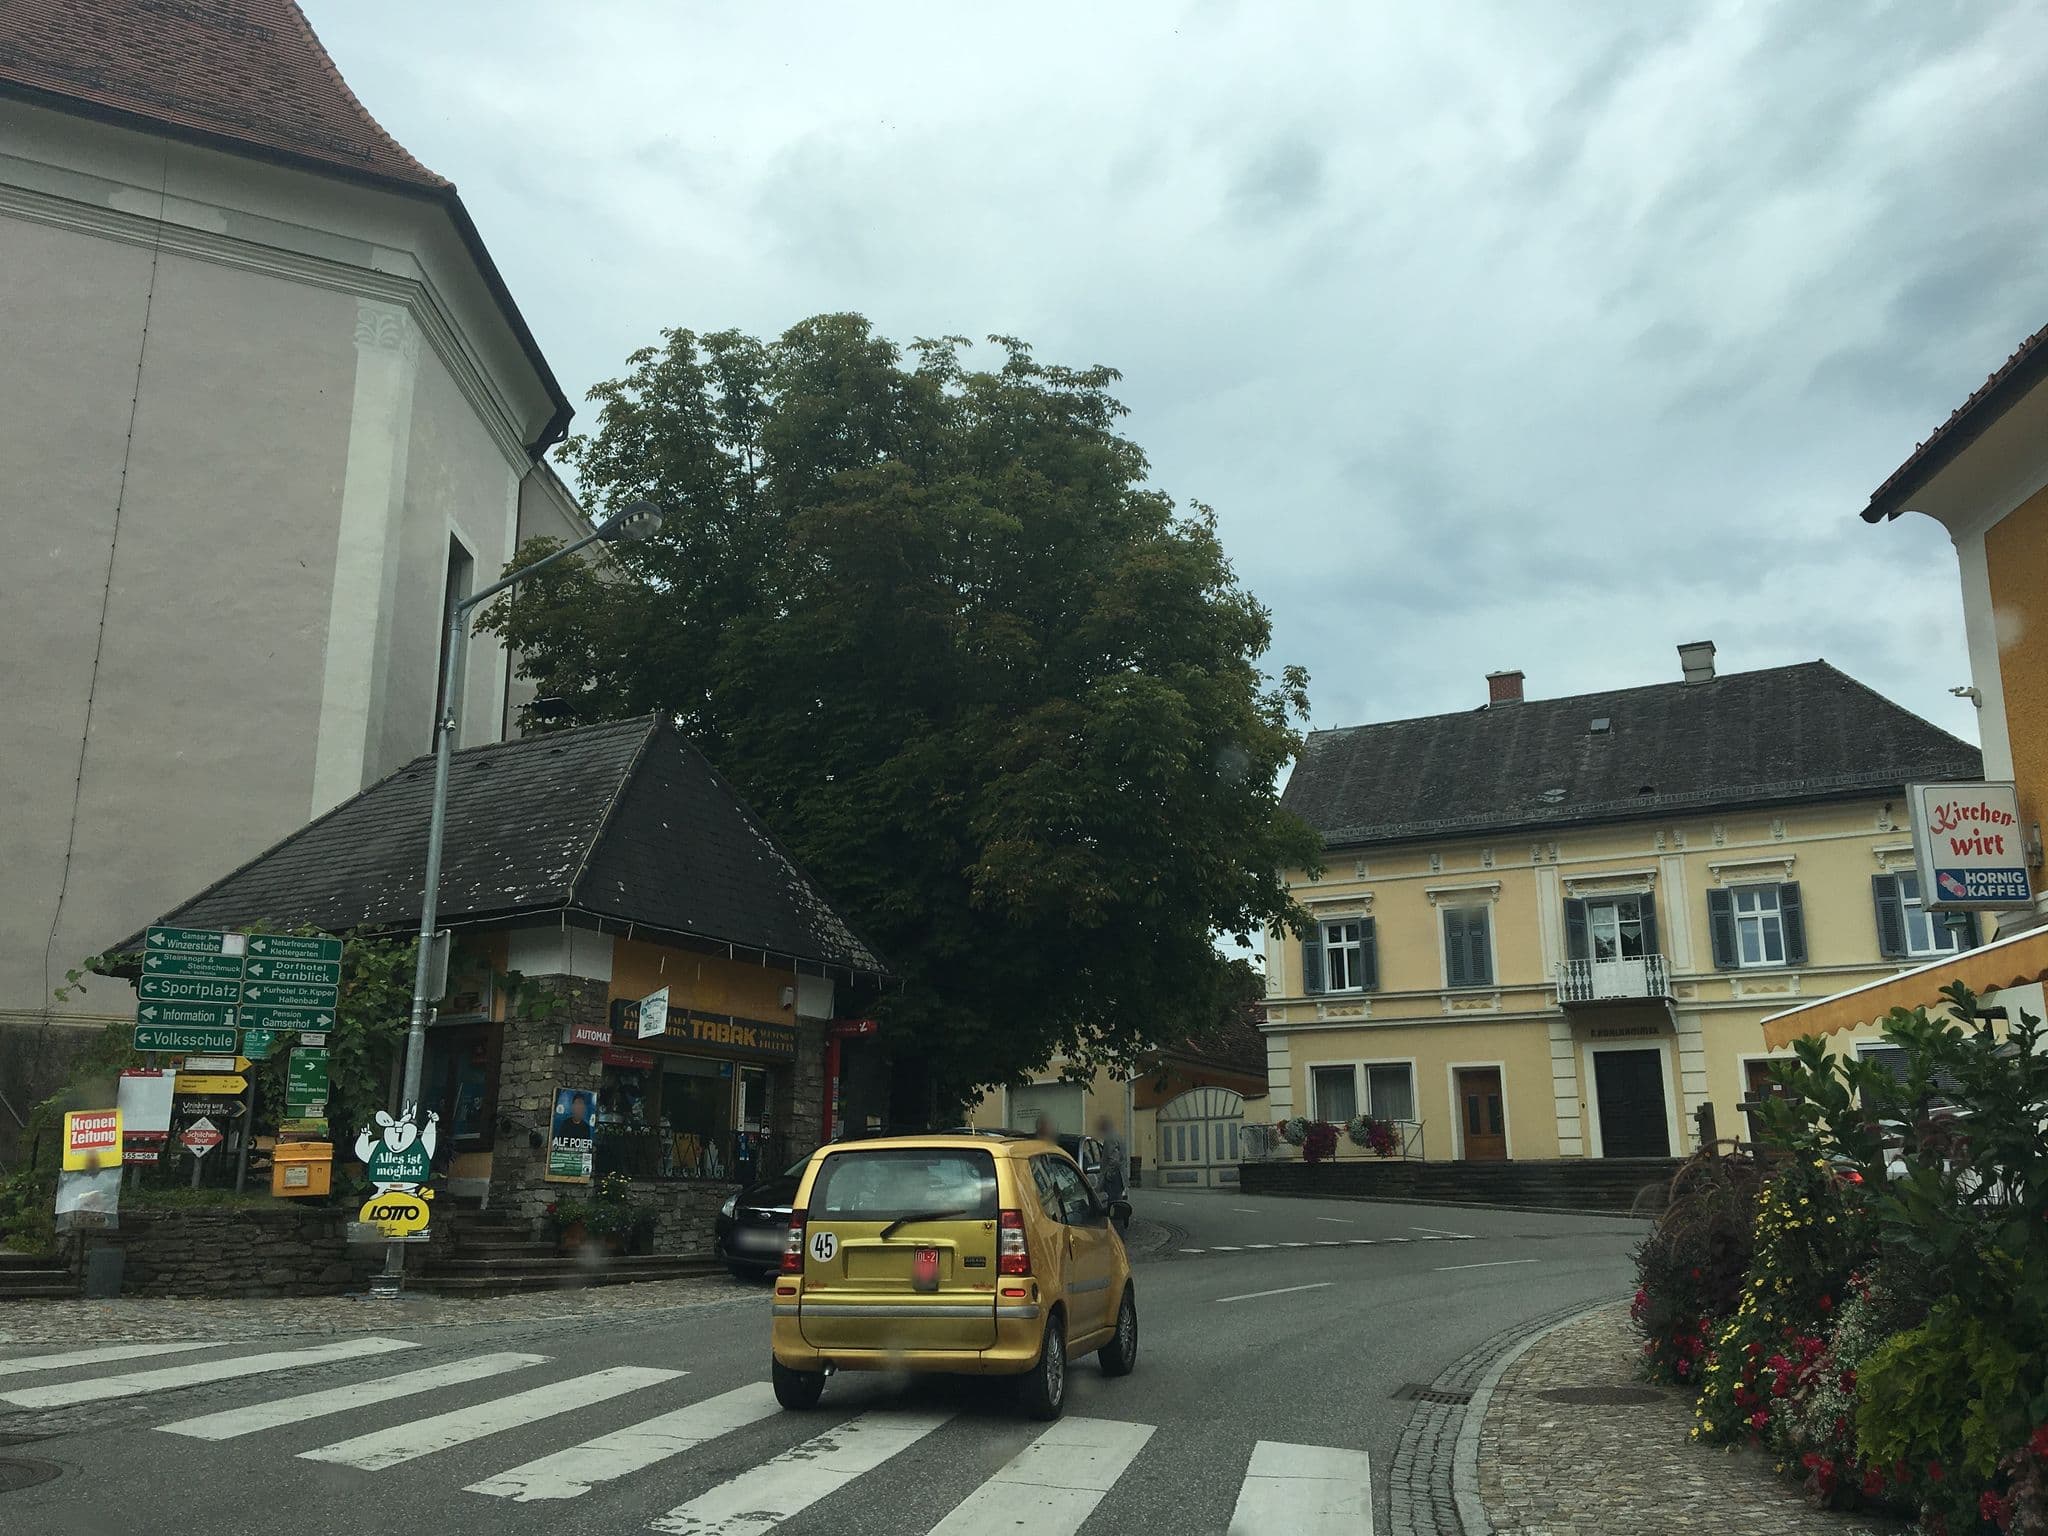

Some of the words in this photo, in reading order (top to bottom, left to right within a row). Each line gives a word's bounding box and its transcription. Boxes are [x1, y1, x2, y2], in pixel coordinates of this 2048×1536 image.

[1930, 801, 2016, 834] Kirchen-
[1950, 828, 2004, 856] wirt
[1964, 872, 2024, 884] HORNIG
[1967, 885, 2027, 897] KAFFEE
[167, 939, 220, 951] Winzerstube
[271, 939, 319, 949] Naturfreunde
[163, 953, 205, 963] Steinknopf
[270, 948, 319, 958] Klettergarten
[187, 963, 241, 973] Steinschmuck
[276, 962, 327, 972] Dorfhotel
[271, 970, 330, 982] Fernblick
[161, 980, 237, 998] Sportplatz
[263, 986, 296, 995] Kurhotel
[278, 996, 319, 1005] Hallenbad
[162, 1009, 215, 1021] Information
[272, 1010, 302, 1018] Pension
[262, 1017, 311, 1029] Gamserhof
[153, 1031, 233, 1046] Volksschule
[576, 1029, 613, 1042] AUTOMAT
[690, 1019, 757, 1047] TABAK
[72, 1117, 115, 1130] Kronen
[71, 1130, 115, 1145] Zeitung
[552, 1136, 569, 1147] ALF
[375, 1152, 404, 1164] Alles
[407, 1153, 422, 1164] ist
[376, 1165, 423, 1181] möglich!
[368, 1205, 420, 1221] LOTTO
[815, 1233, 833, 1259] 45
